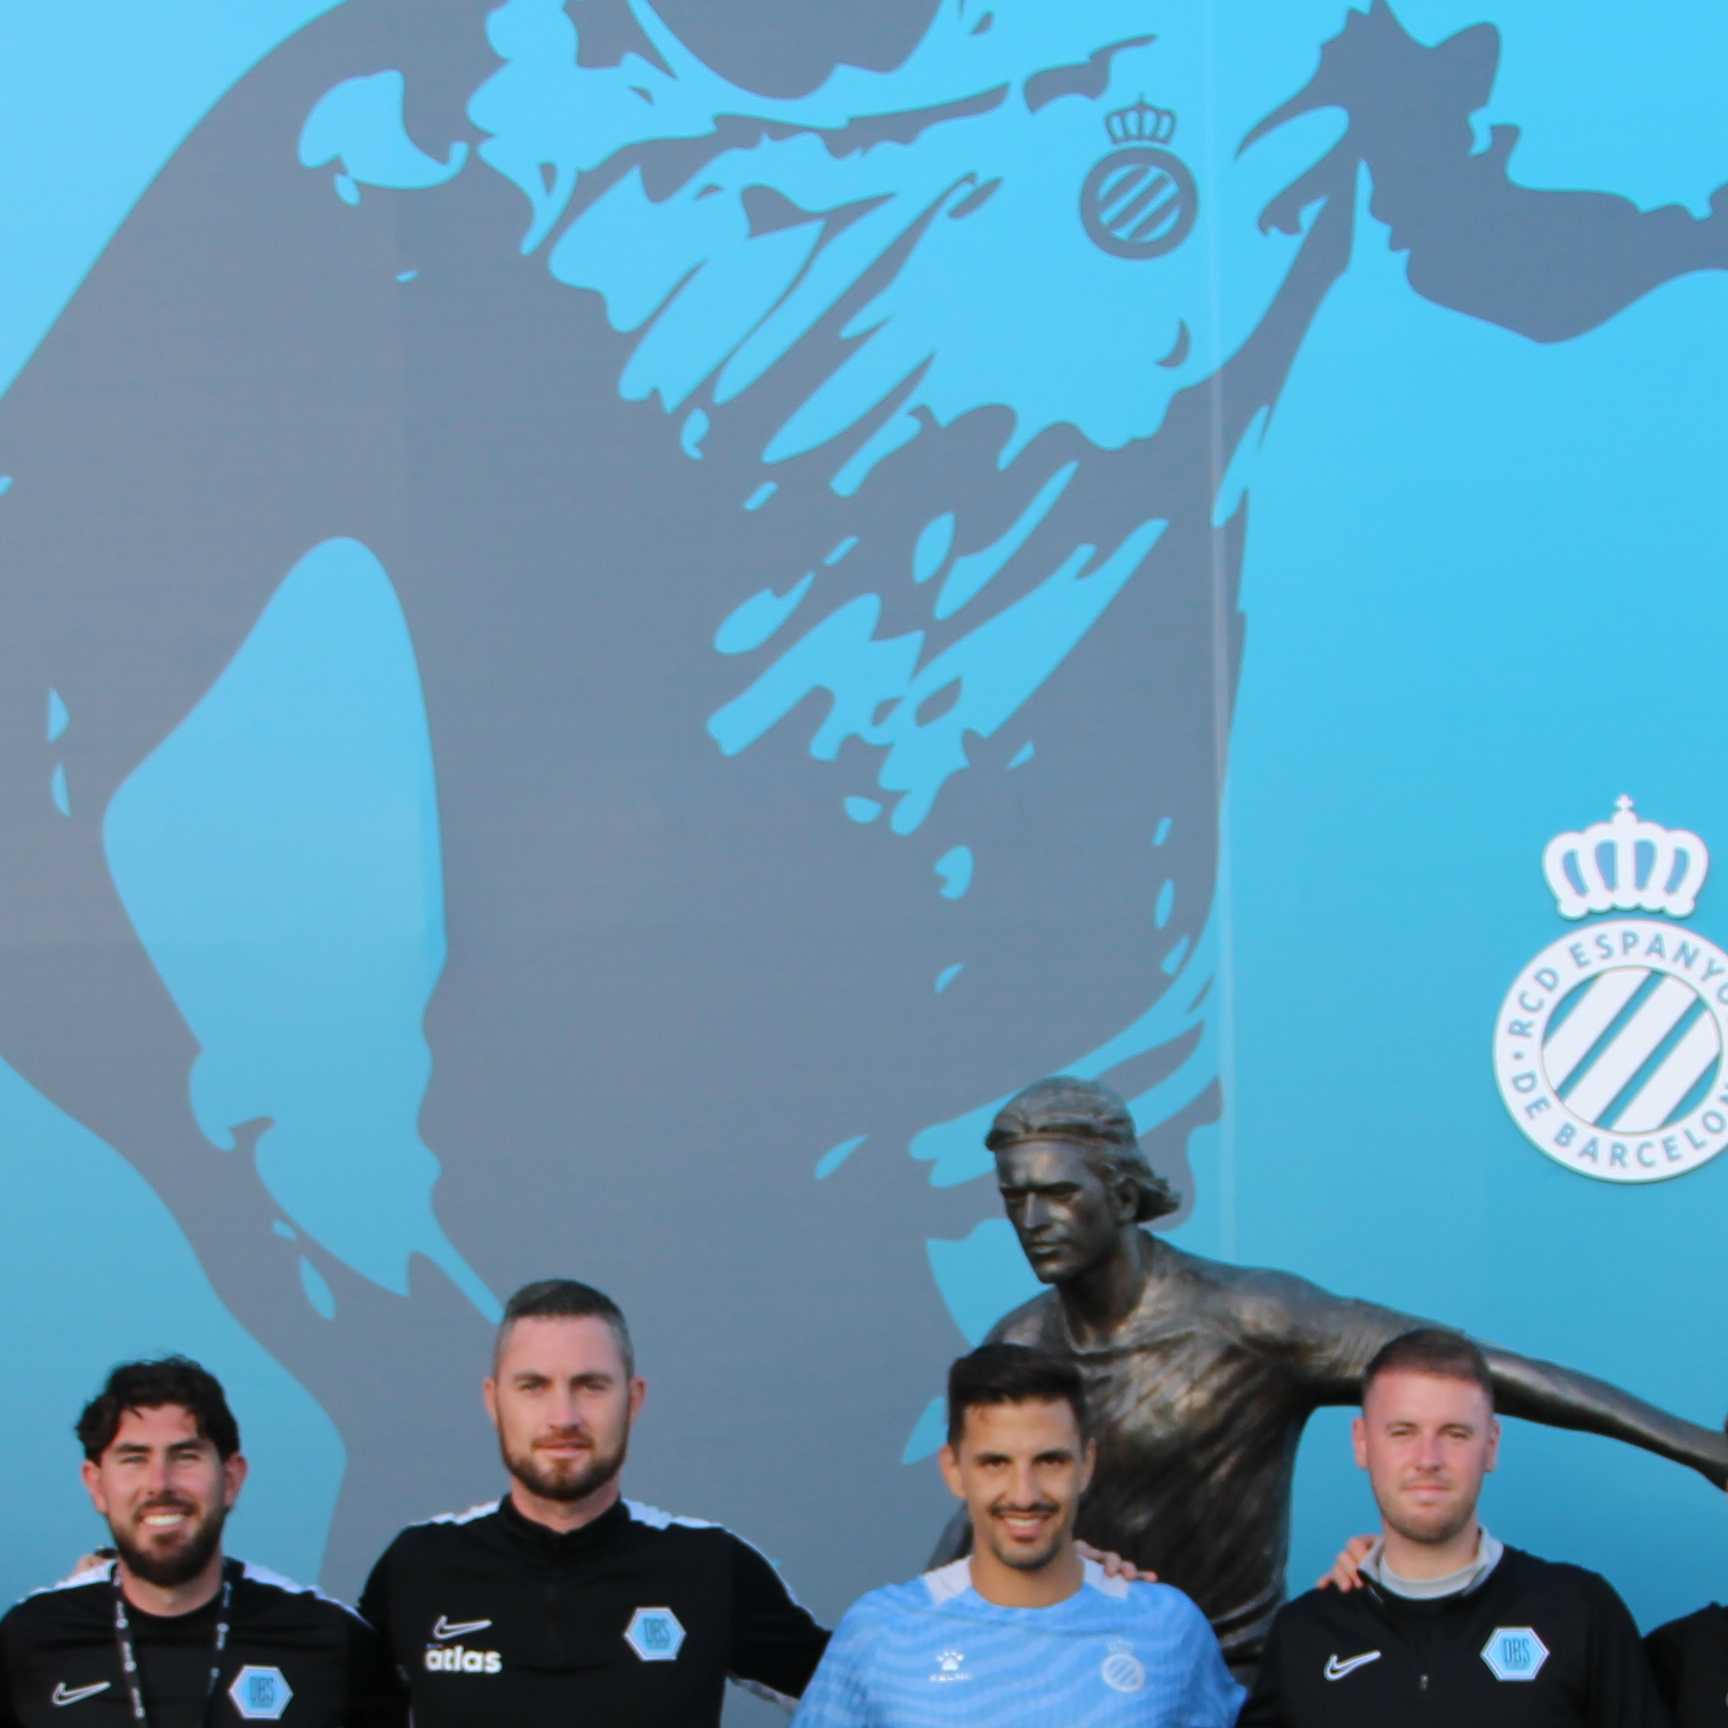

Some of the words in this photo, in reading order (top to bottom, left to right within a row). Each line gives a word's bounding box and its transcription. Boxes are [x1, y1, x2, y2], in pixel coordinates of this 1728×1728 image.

[1508, 966, 1560, 1038] RCD
[1511, 1070, 1552, 1120] DE
[425, 1644, 503, 1674] atlas
